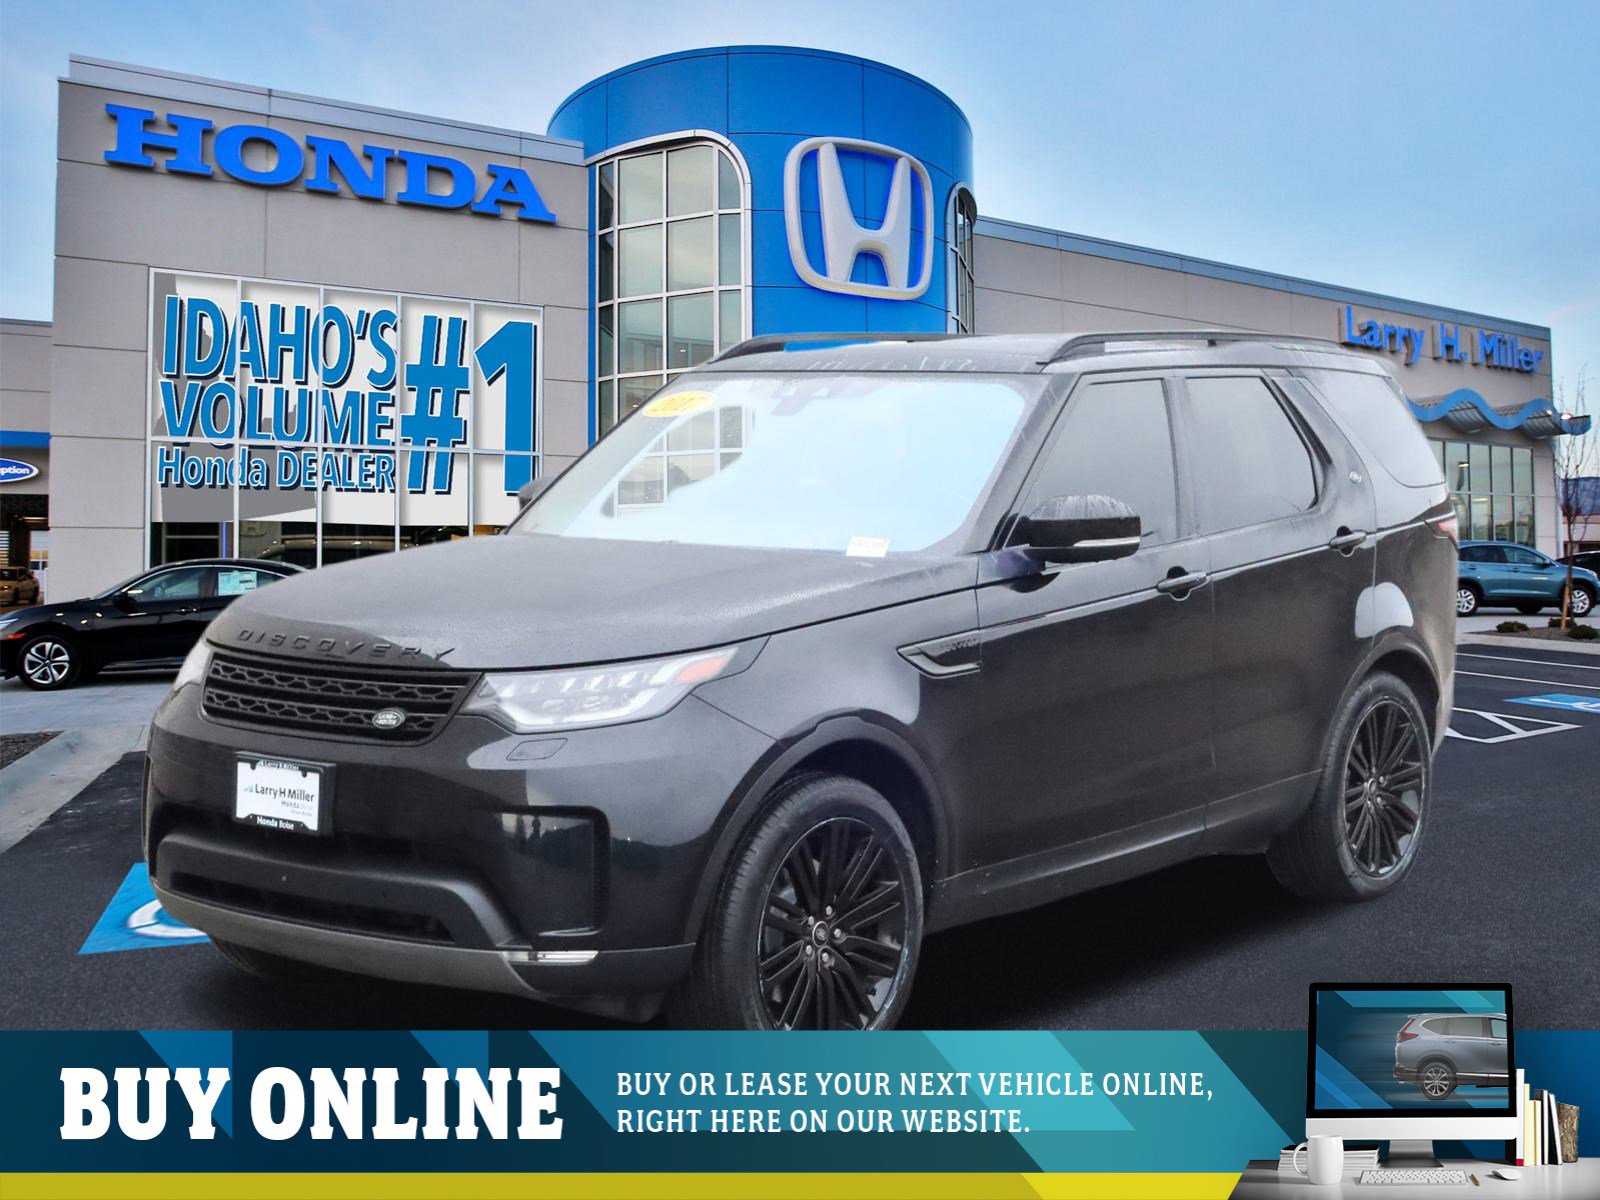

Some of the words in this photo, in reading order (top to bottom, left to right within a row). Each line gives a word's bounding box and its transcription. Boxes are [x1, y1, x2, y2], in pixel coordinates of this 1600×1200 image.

[104, 103, 557, 224] HONDA
[162, 294, 398, 391] IDAHO'S
[1345, 305, 1424, 366] Larry
[1438, 322, 1468, 362] H.
[1479, 329, 1544, 372] Miller
[159, 379, 397, 451] VOLUME
[401, 314, 538, 496] #1
[0, 465, 30, 476] ption
[156, 445, 271, 490] Honda
[276, 451, 397, 494] DEALER
[238, 628, 456, 662] DISCOVERY
[255, 783, 278, 800] Larry
[279, 787, 286, 798] H
[287, 788, 315, 803] Miller
[256, 816, 278, 828] Honda
